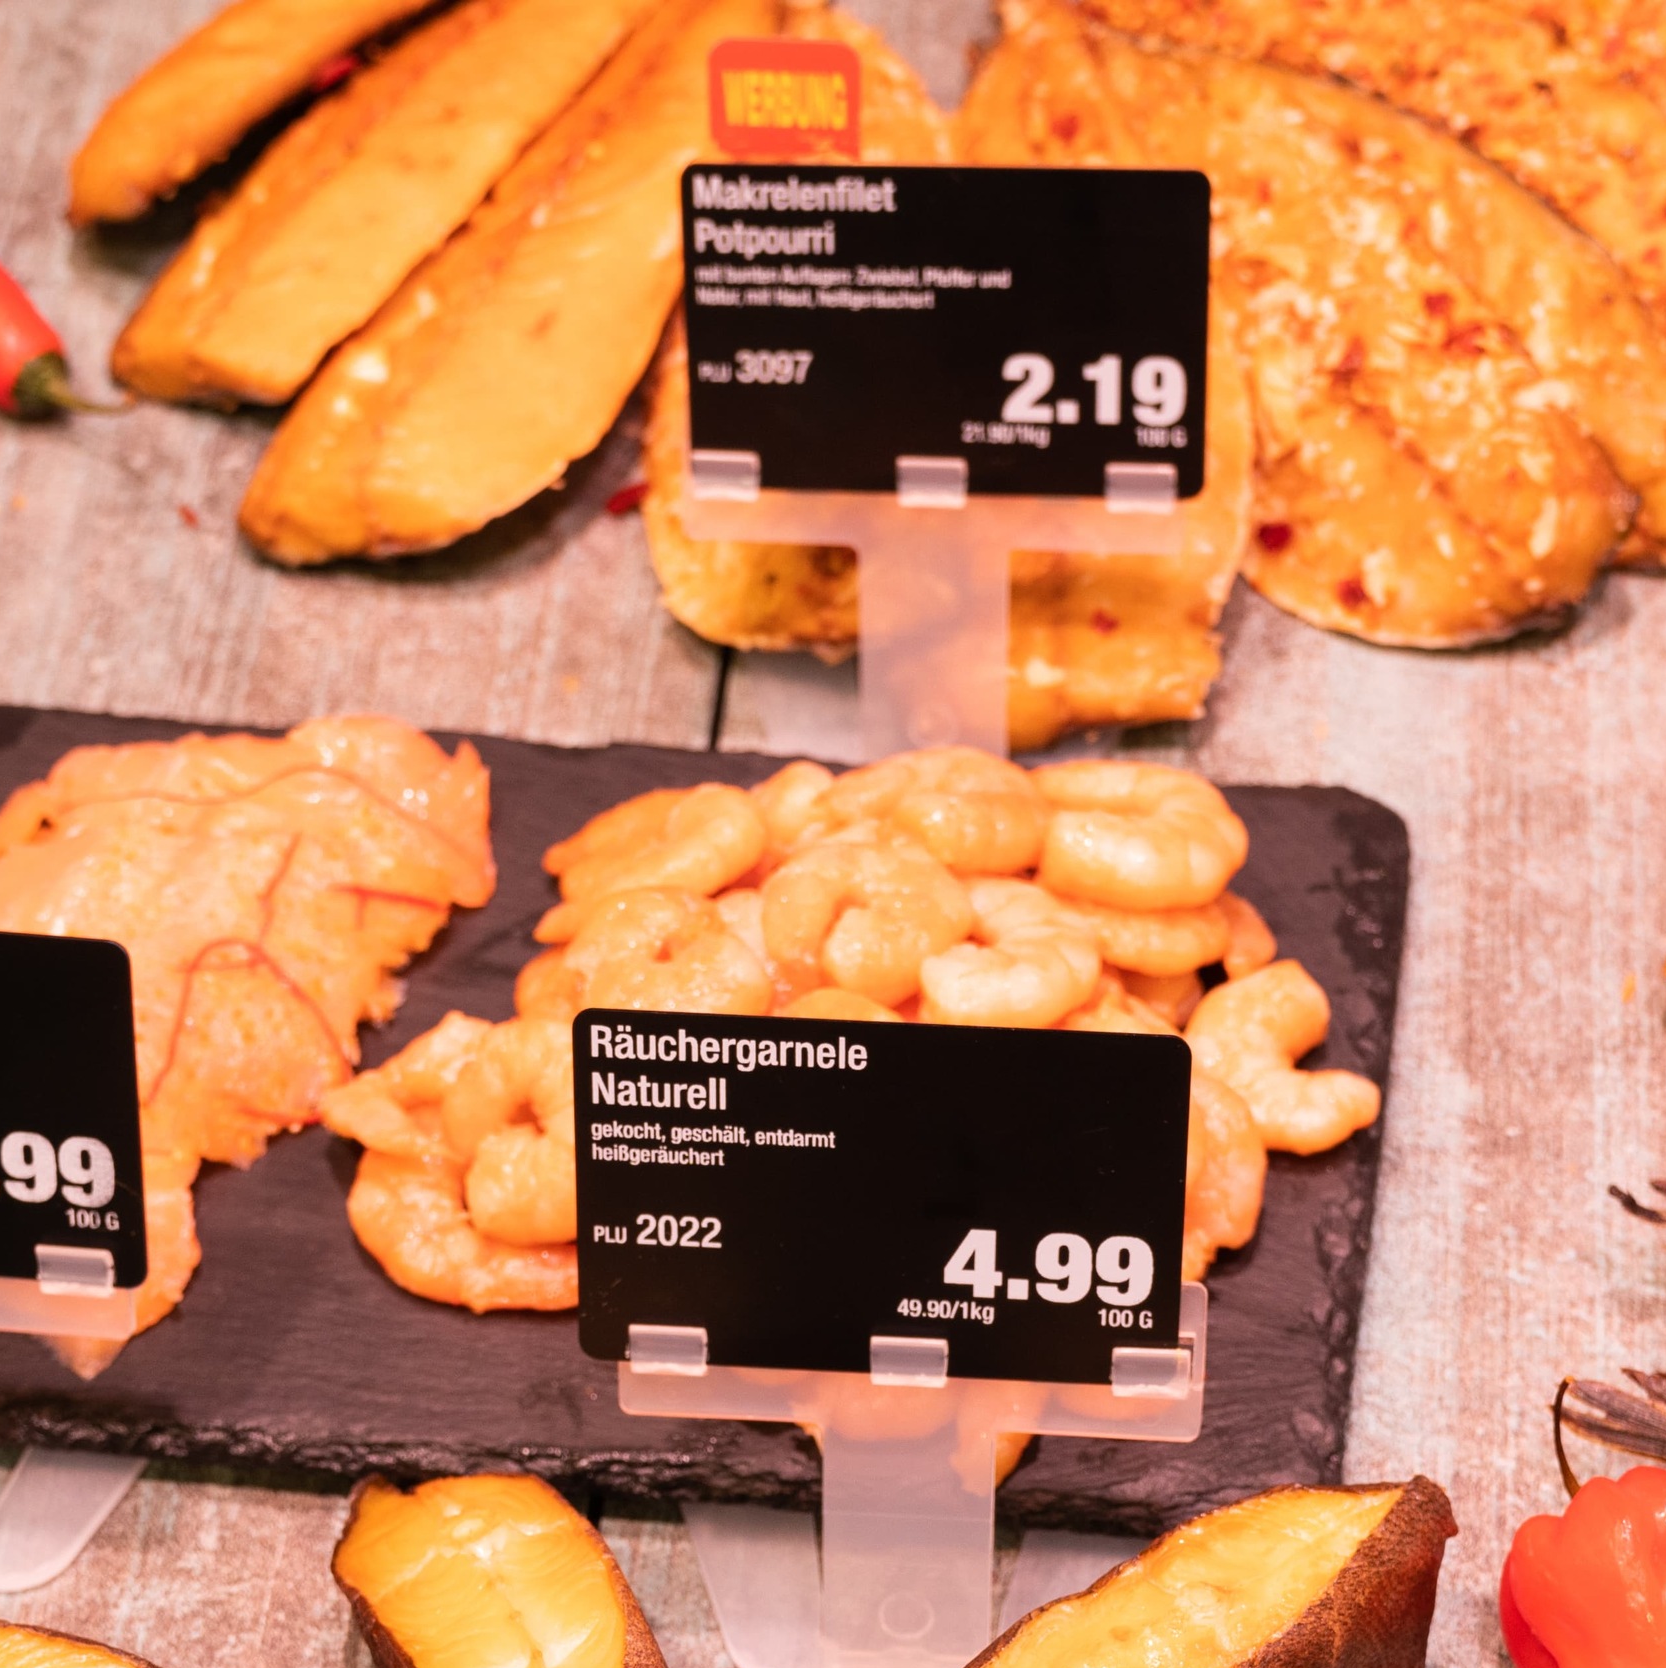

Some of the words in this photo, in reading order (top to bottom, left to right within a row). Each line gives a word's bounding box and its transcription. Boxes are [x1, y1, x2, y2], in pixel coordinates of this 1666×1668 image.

[721, 69, 848, 131] WERBUNG
[692, 174, 897, 213] Makrelenfilet
[694, 219, 836, 260] Potpourri
[734, 349, 814, 384] 3097
[1000, 353, 1188, 427] 2.19
[1136, 426, 1169, 447] 100
[1171, 427, 1187, 448] G
[589, 1024, 868, 1071] Räuchergarnele
[590, 1072, 727, 1111] Naturell
[591, 1121, 667, 1144] gekocht,
[671, 1123, 751, 1148] geschält,
[754, 1128, 836, 1149] entdarmt
[591, 1143, 725, 1167] heißgeräuchert
[66, 1207, 101, 1229] 100
[105, 1211, 119, 1231] G
[594, 1225, 627, 1244] PLU
[636, 1214, 722, 1249] 2022
[943, 1228, 1155, 1306] 4.99
[897, 1298, 995, 1325] 49.90/1kg
[1098, 1309, 1133, 1328] 100
[1139, 1311, 1153, 1329] G
